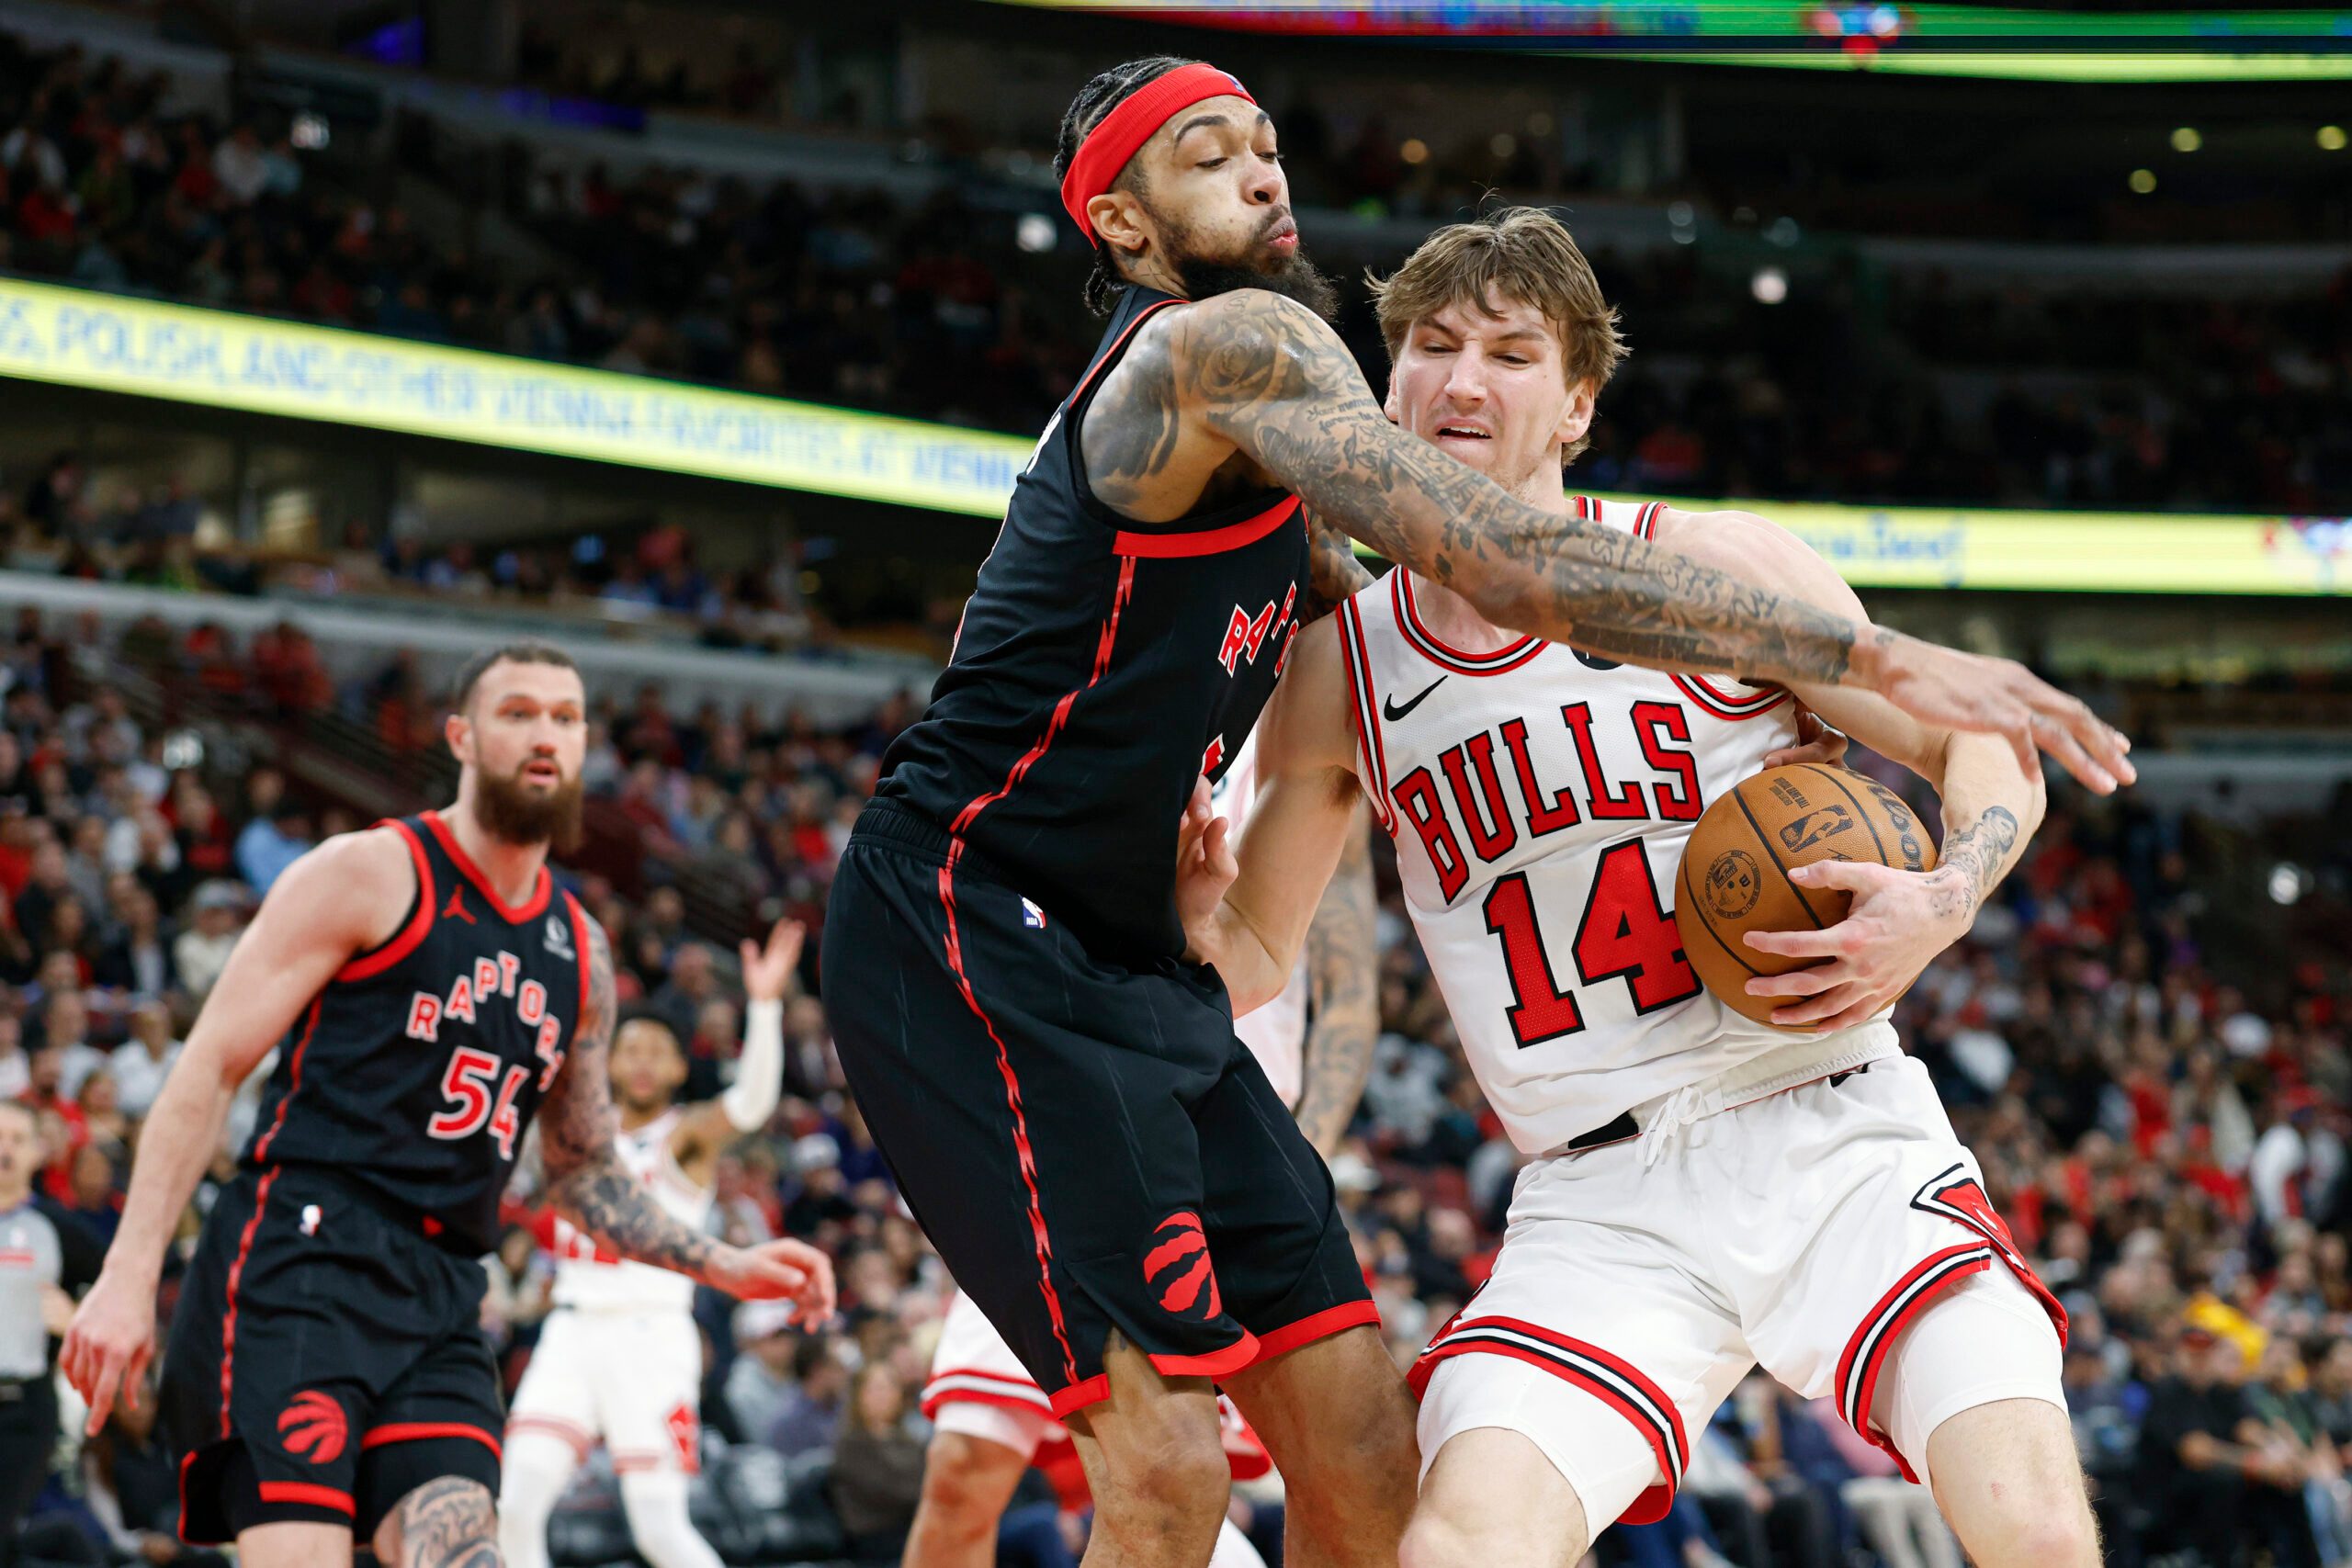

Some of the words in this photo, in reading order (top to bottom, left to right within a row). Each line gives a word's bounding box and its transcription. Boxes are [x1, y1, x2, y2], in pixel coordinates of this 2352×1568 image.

[1391, 701, 1703, 905] BULLS
[1483, 837, 1703, 1049] 14
[427, 1046, 530, 1161] 54
